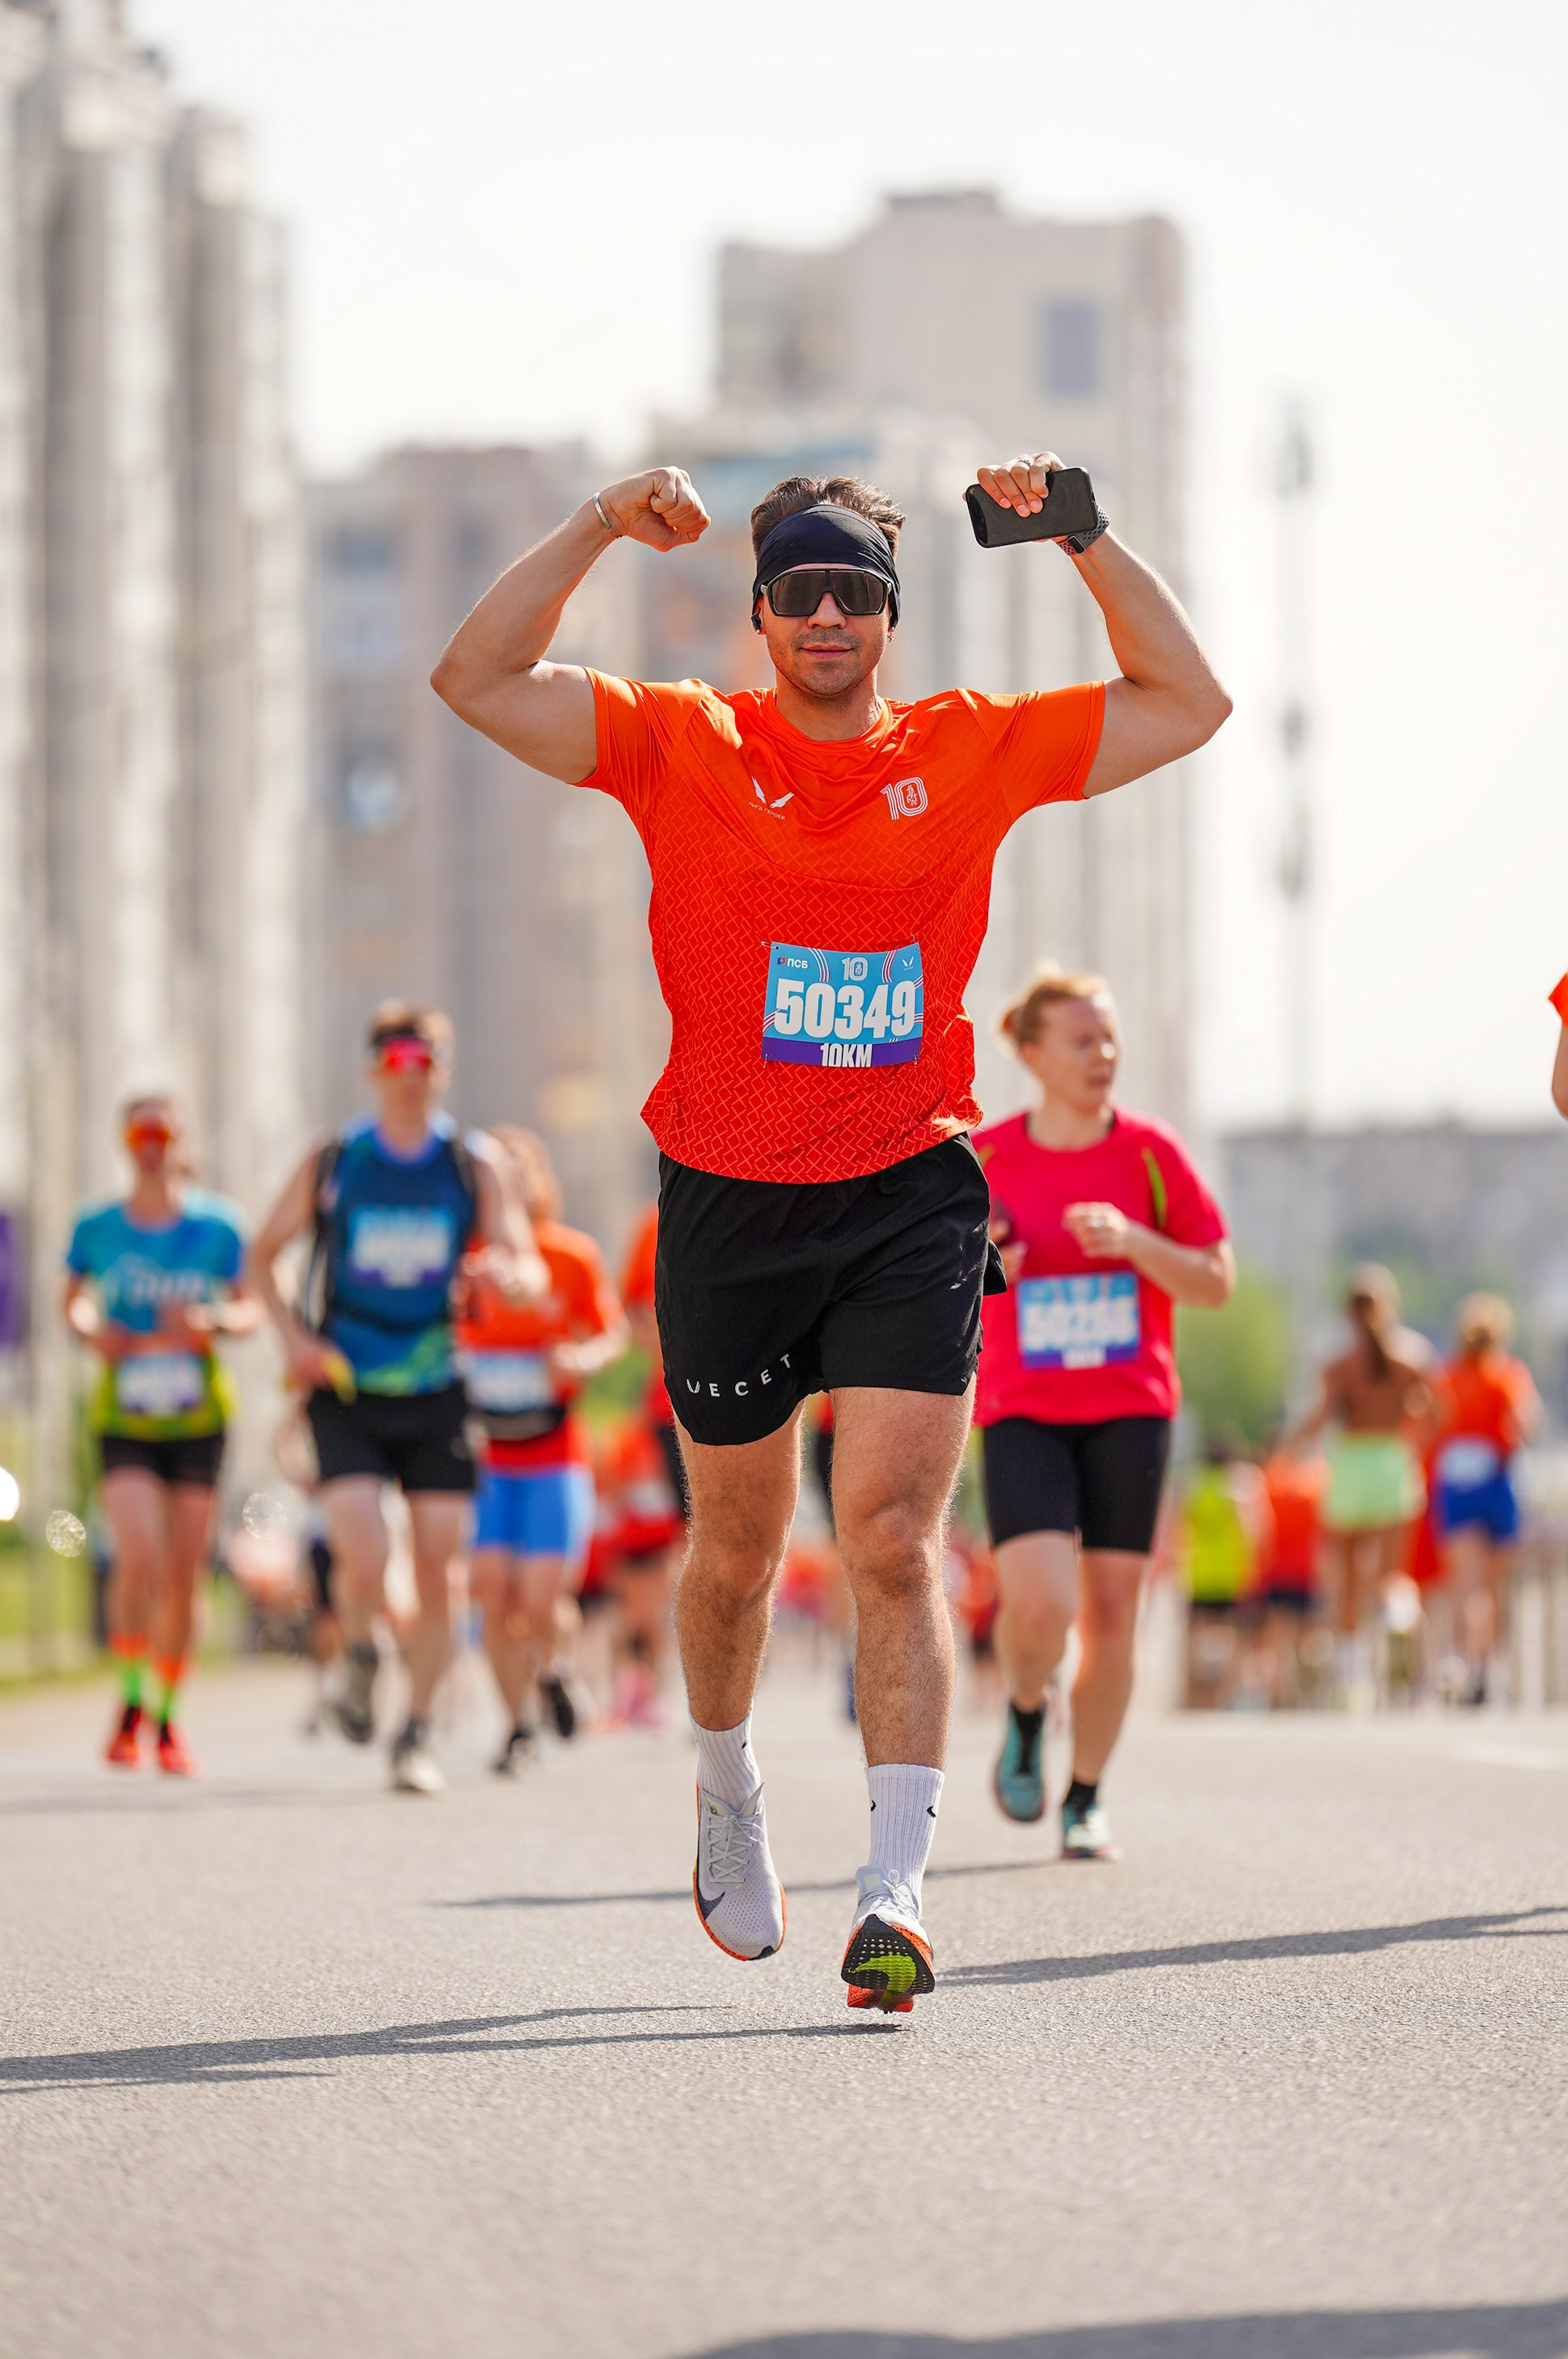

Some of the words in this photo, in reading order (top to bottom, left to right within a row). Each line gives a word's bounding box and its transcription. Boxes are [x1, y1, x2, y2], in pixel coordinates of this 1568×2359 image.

[880, 776, 928, 821] 10
[787, 958, 808, 969] ПСБ
[841, 957, 869, 981] 10
[774, 978, 916, 1040] 50349
